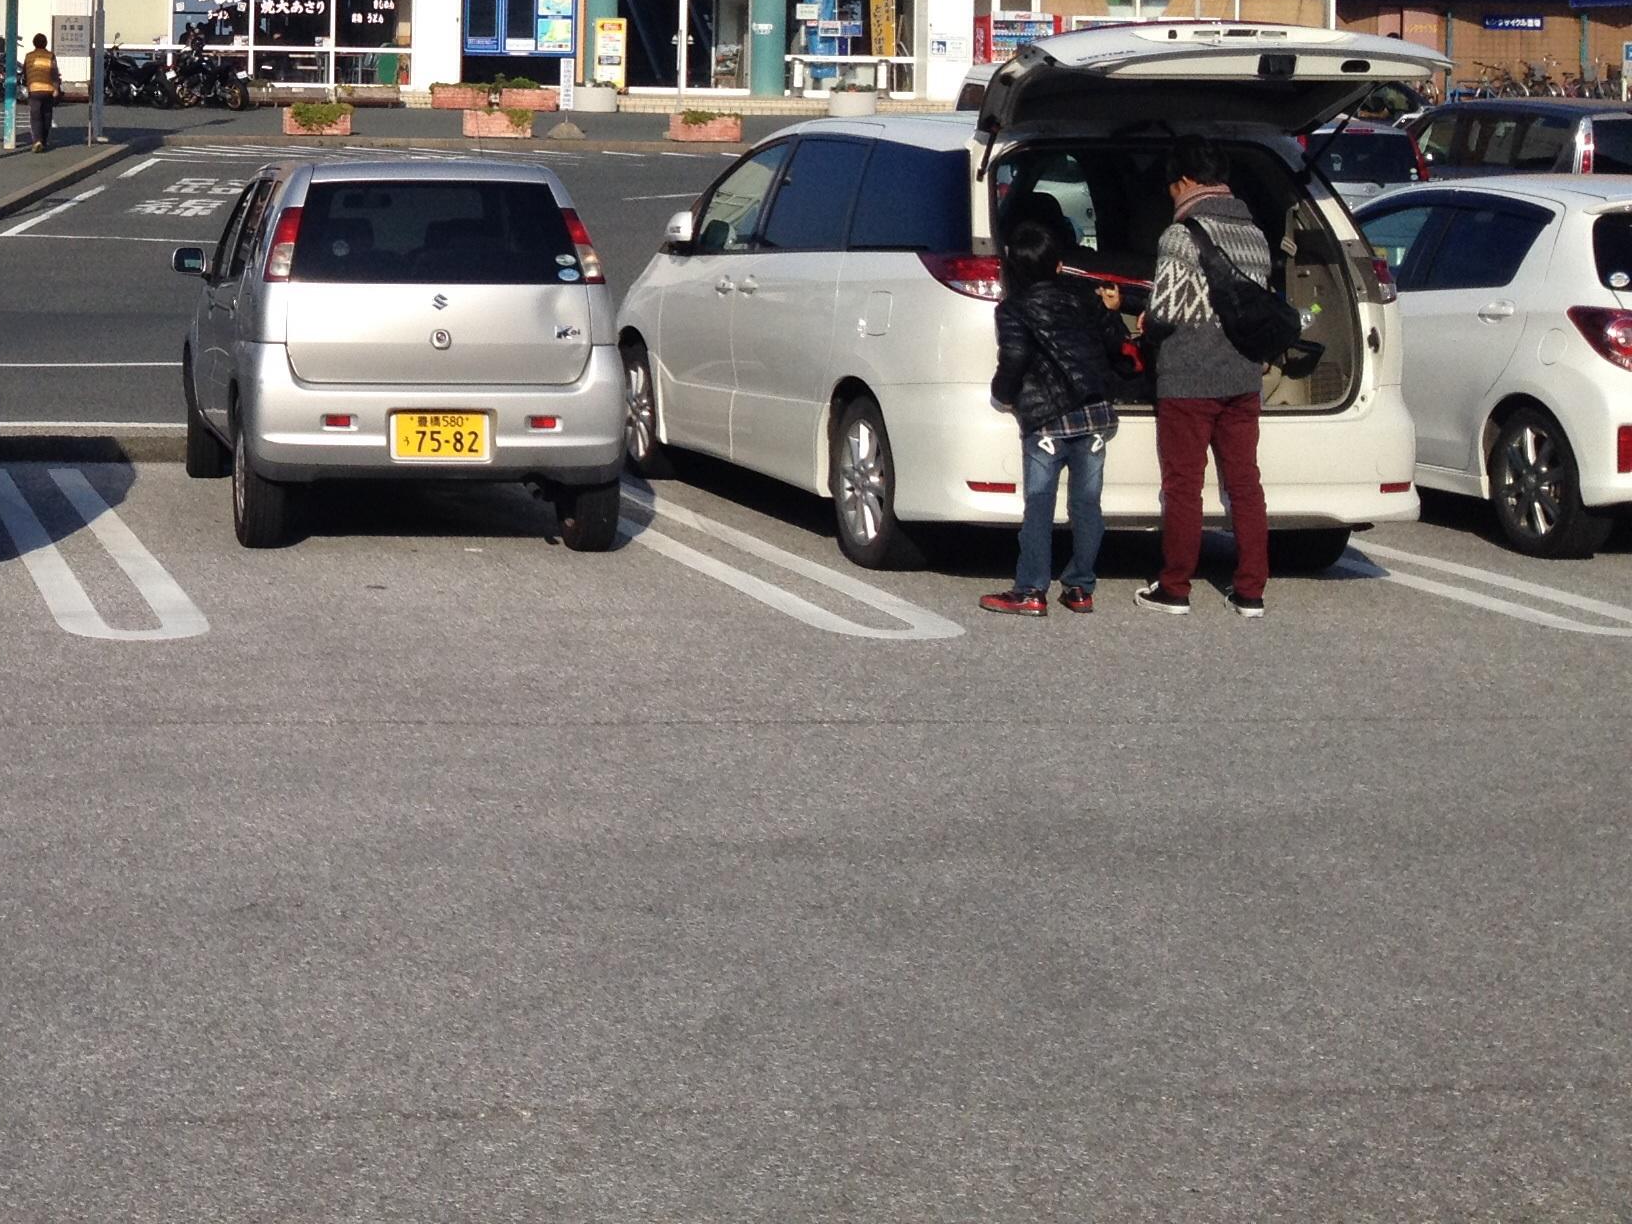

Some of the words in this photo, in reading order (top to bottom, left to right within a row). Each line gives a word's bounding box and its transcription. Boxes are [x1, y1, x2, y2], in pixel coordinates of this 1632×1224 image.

[260, 0, 326, 15] 焼大あさり
[415, 430, 479, 453] 75-82
